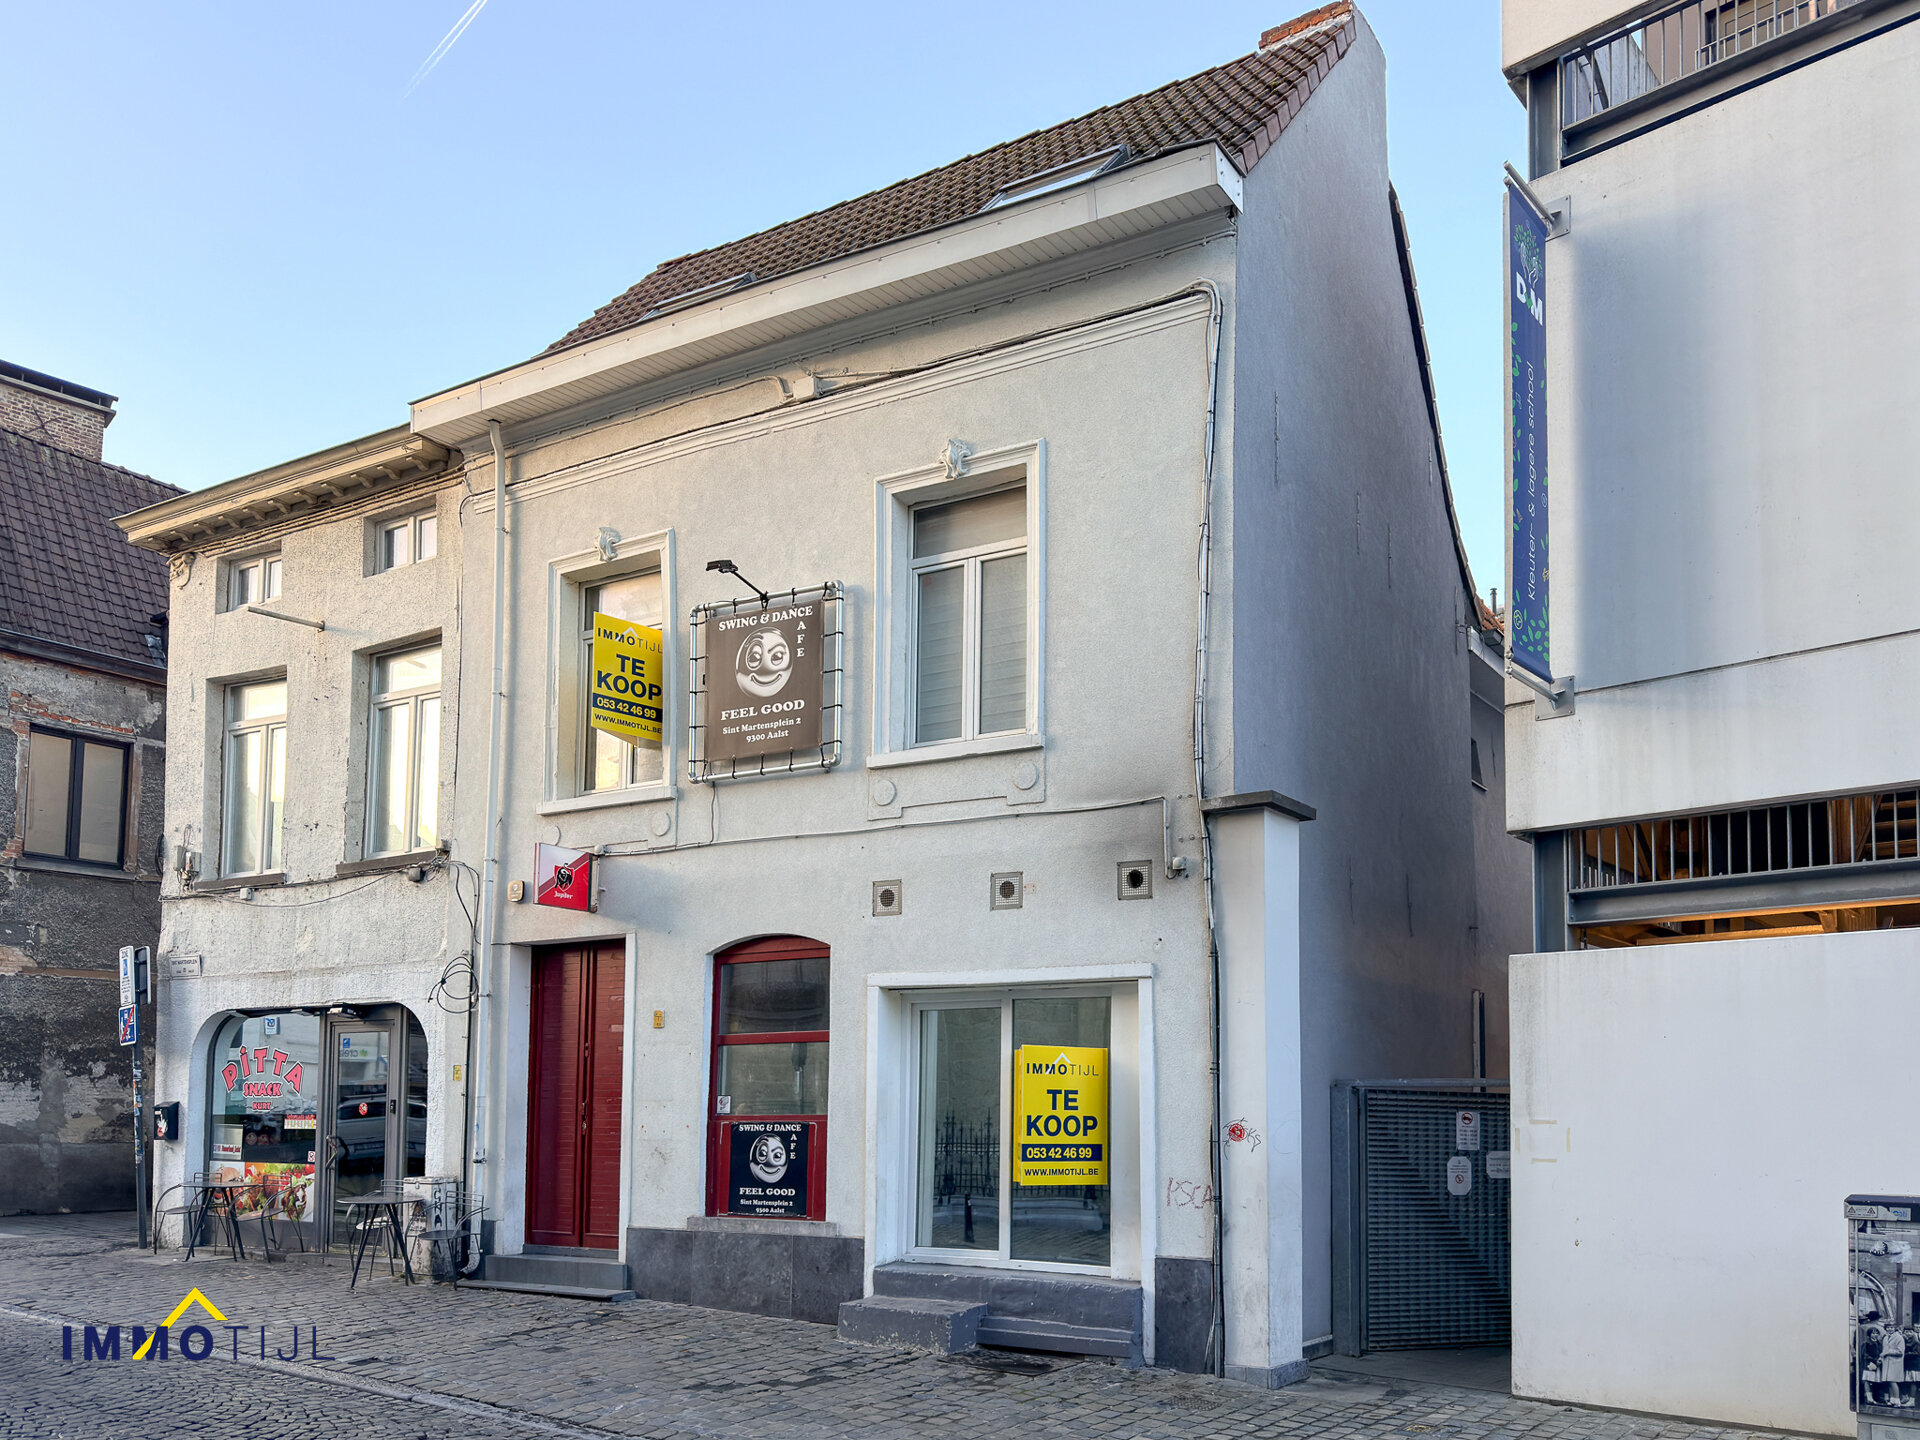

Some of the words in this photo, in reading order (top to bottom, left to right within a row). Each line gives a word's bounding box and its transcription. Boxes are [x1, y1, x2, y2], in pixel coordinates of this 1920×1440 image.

[1526, 361, 1535, 429] school
[1527, 434, 1537, 497] lagere
[1528, 503, 1536, 517] &
[718, 616, 758, 631] SWING
[760, 613, 770, 624] &
[772, 606, 813, 623] DANCE
[616, 653, 645, 678] TE
[597, 670, 662, 700] KOOP
[597, 697, 615, 709] 053
[617, 702, 629, 713] 42
[631, 705, 643, 716] 46
[644, 708, 657, 719] 99
[720, 706, 758, 720] FEEL
[761, 699, 805, 715] GOOD
[594, 713, 662, 734] WWW.IMMOTIJL.BE
[722, 726, 740, 735] Sint
[741, 717, 794, 732] Martensplein
[746, 734, 765, 743] 9300
[767, 730, 789, 740] Aalst
[1026, 1062, 1099, 1076] IMMOTIJL
[243, 1082, 282, 1097] SNACK
[252, 1102, 271, 1111] KURT
[1047, 1089, 1079, 1111] TE
[738, 1124, 765, 1132] SWING
[766, 1124, 773, 1132] &
[774, 1124, 802, 1132] DANCE
[1026, 1115, 1098, 1137] KOOP
[1026, 1147, 1047, 1159] 053
[1048, 1147, 1062, 1159] 42
[1063, 1147, 1077, 1159] 46
[1078, 1147, 1092, 1159] 99
[1024, 1168, 1099, 1176] WWW.IMMOTIJL.BE
[739, 1187, 764, 1195] FEEL
[766, 1187, 795, 1196] GOOD
[752, 1199, 788, 1207] Martensplein
